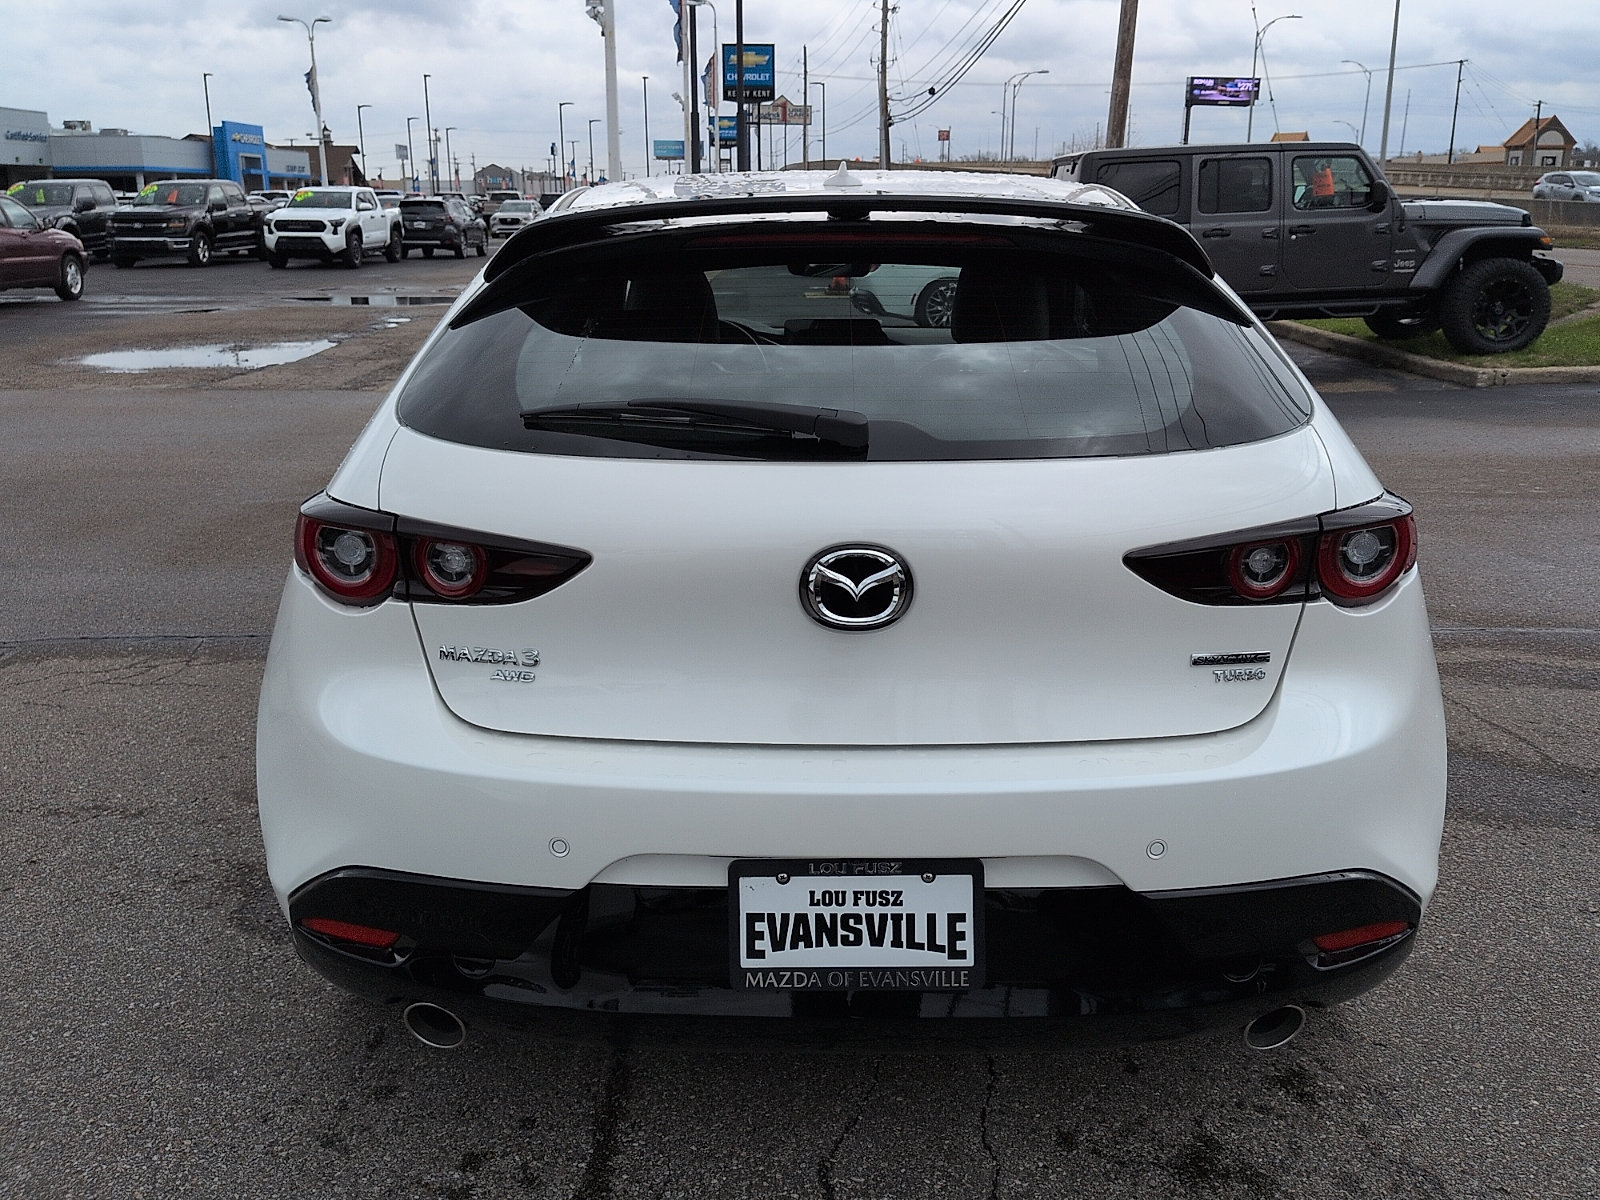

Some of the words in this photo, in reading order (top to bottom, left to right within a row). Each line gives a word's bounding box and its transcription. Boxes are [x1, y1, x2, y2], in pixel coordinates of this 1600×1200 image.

[727, 73, 770, 81] CHVROLET
[1394, 259, 1415, 268] Jeep
[490, 669, 536, 683] AWD
[1212, 668, 1266, 683] TURBO
[808, 863, 847, 875] LOU
[853, 863, 903, 875] FUSZ
[808, 890, 847, 907] LOU
[853, 890, 904, 907] FUSZ
[745, 912, 968, 960] EVANSVILLE
[745, 971, 821, 988] MAZDA
[827, 971, 853, 988] OF
[859, 971, 970, 988] EVANSVILLE
